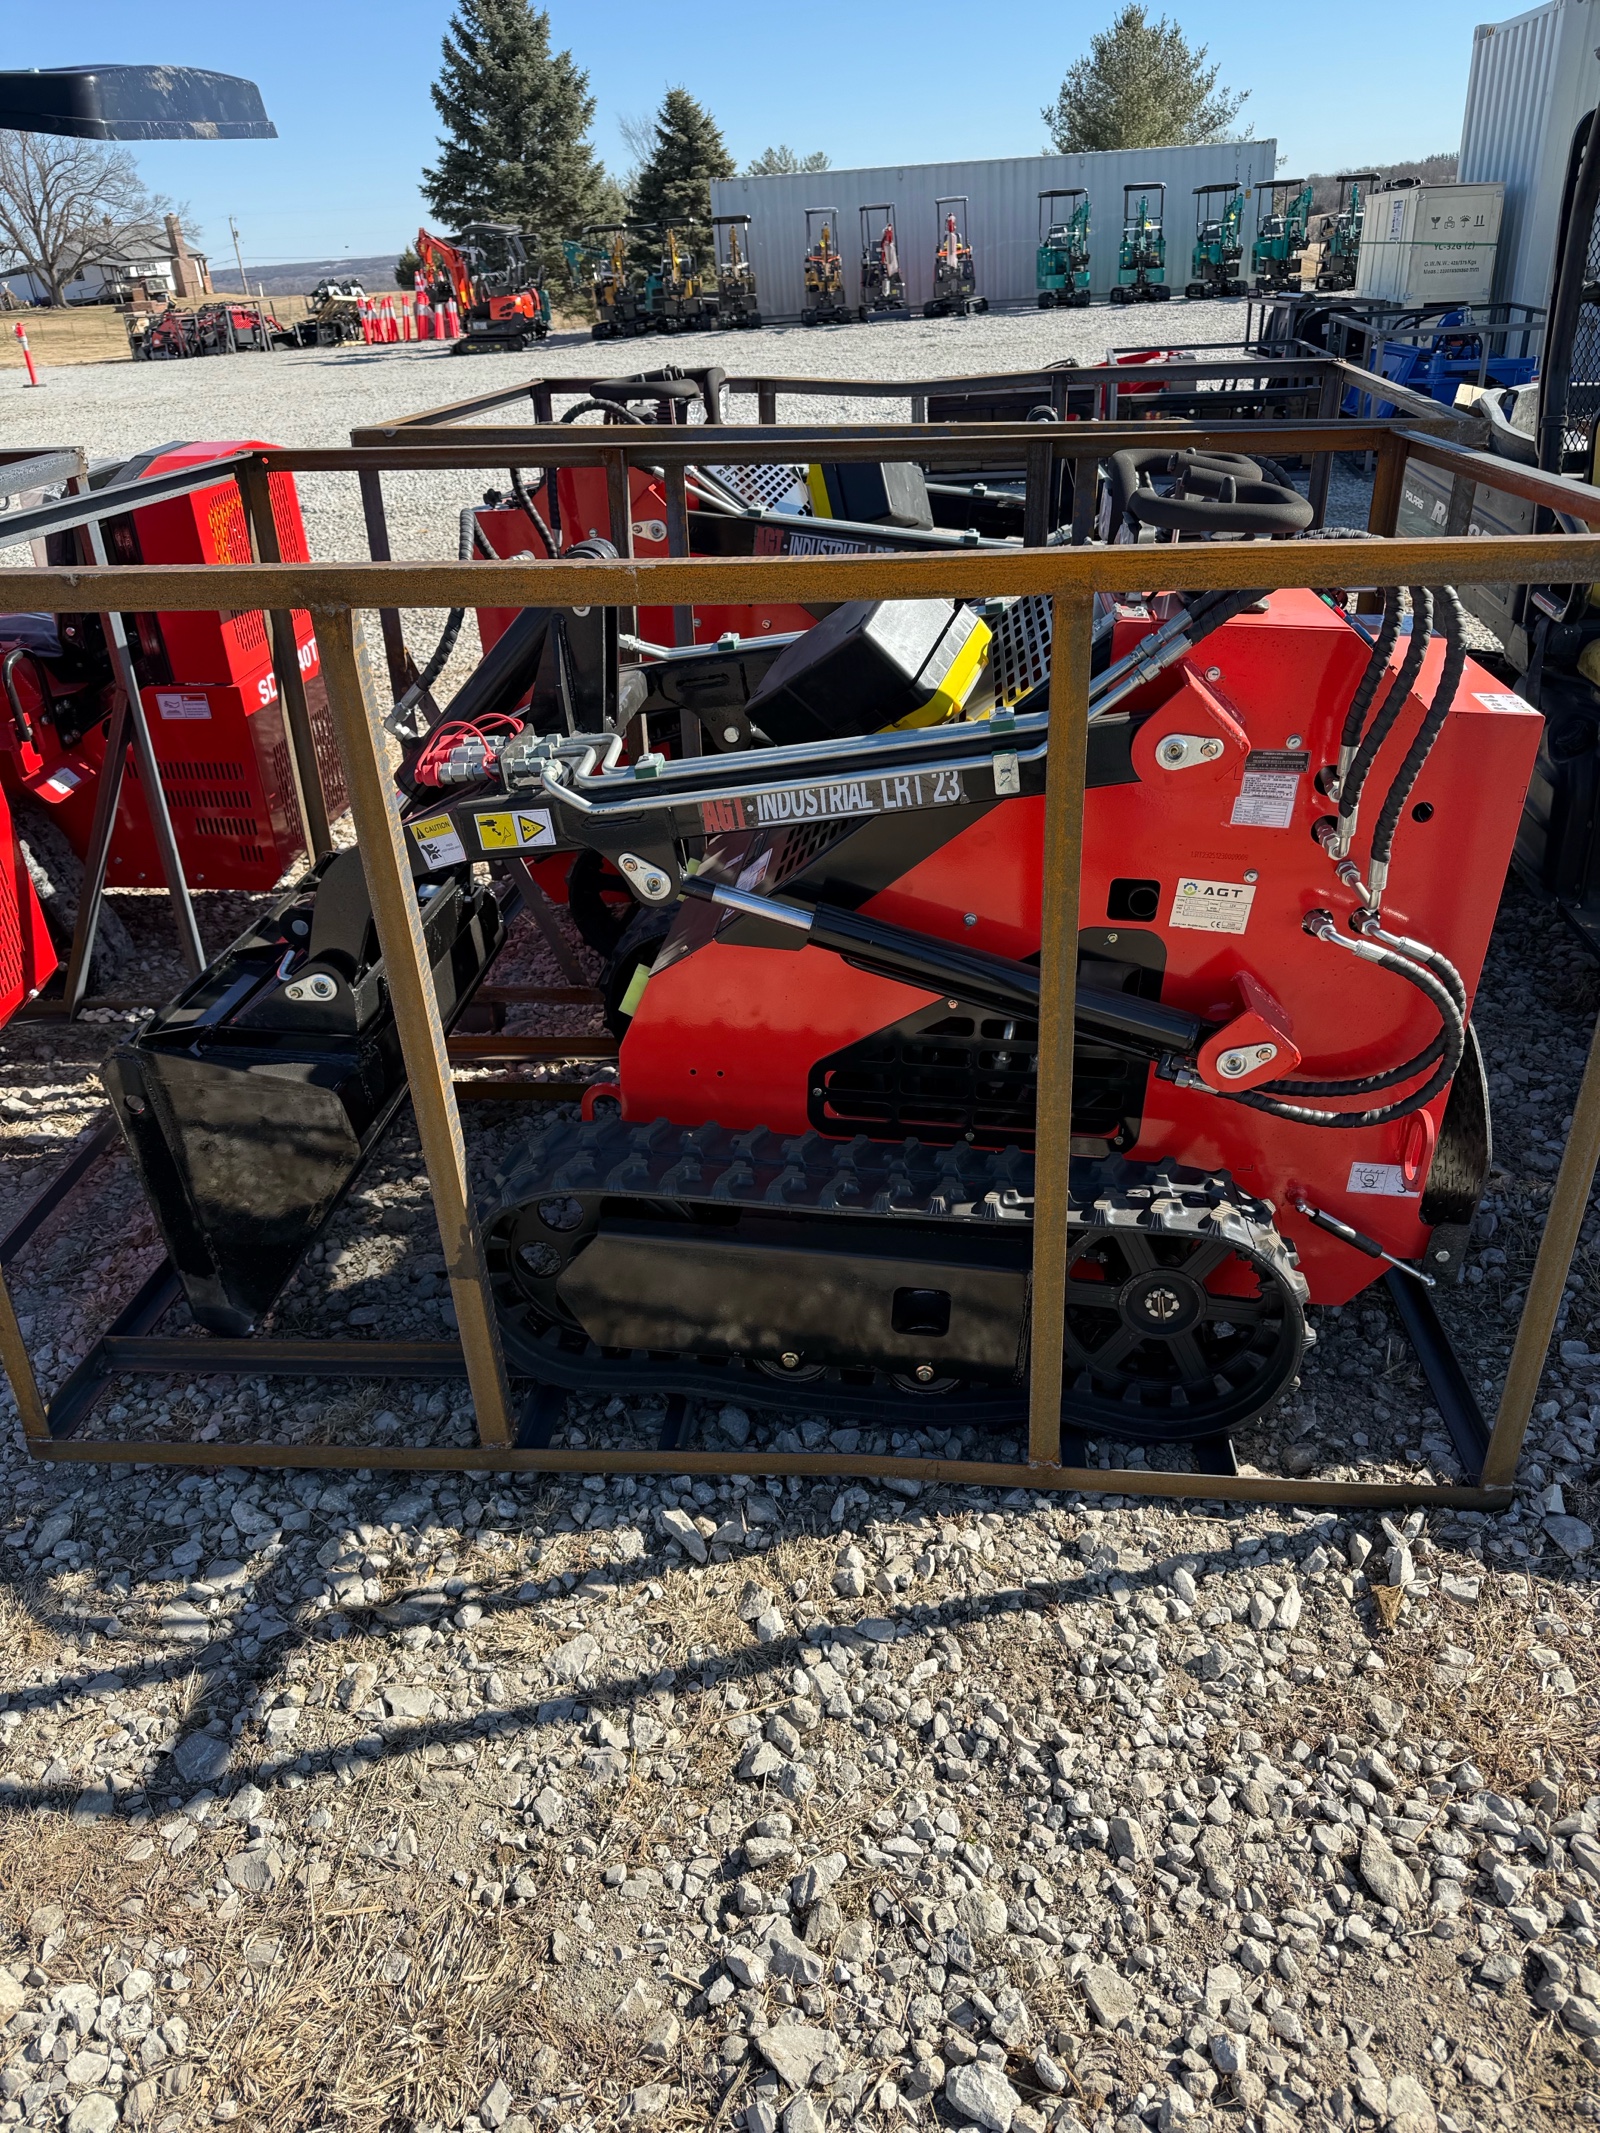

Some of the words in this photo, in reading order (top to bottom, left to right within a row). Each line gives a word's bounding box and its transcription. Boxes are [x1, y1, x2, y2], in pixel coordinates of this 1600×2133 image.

[1404, 490, 1425, 510] POLARIS
[753, 525, 784, 556] AGT
[702, 797, 746, 833] AGT
[757, 782, 874, 821] INDUSTRIAL
[881, 775, 923, 809] LRT
[931, 771, 960, 803] 23
[424, 821, 450, 834] CAUTION
[1204, 886, 1244, 898] AGT
